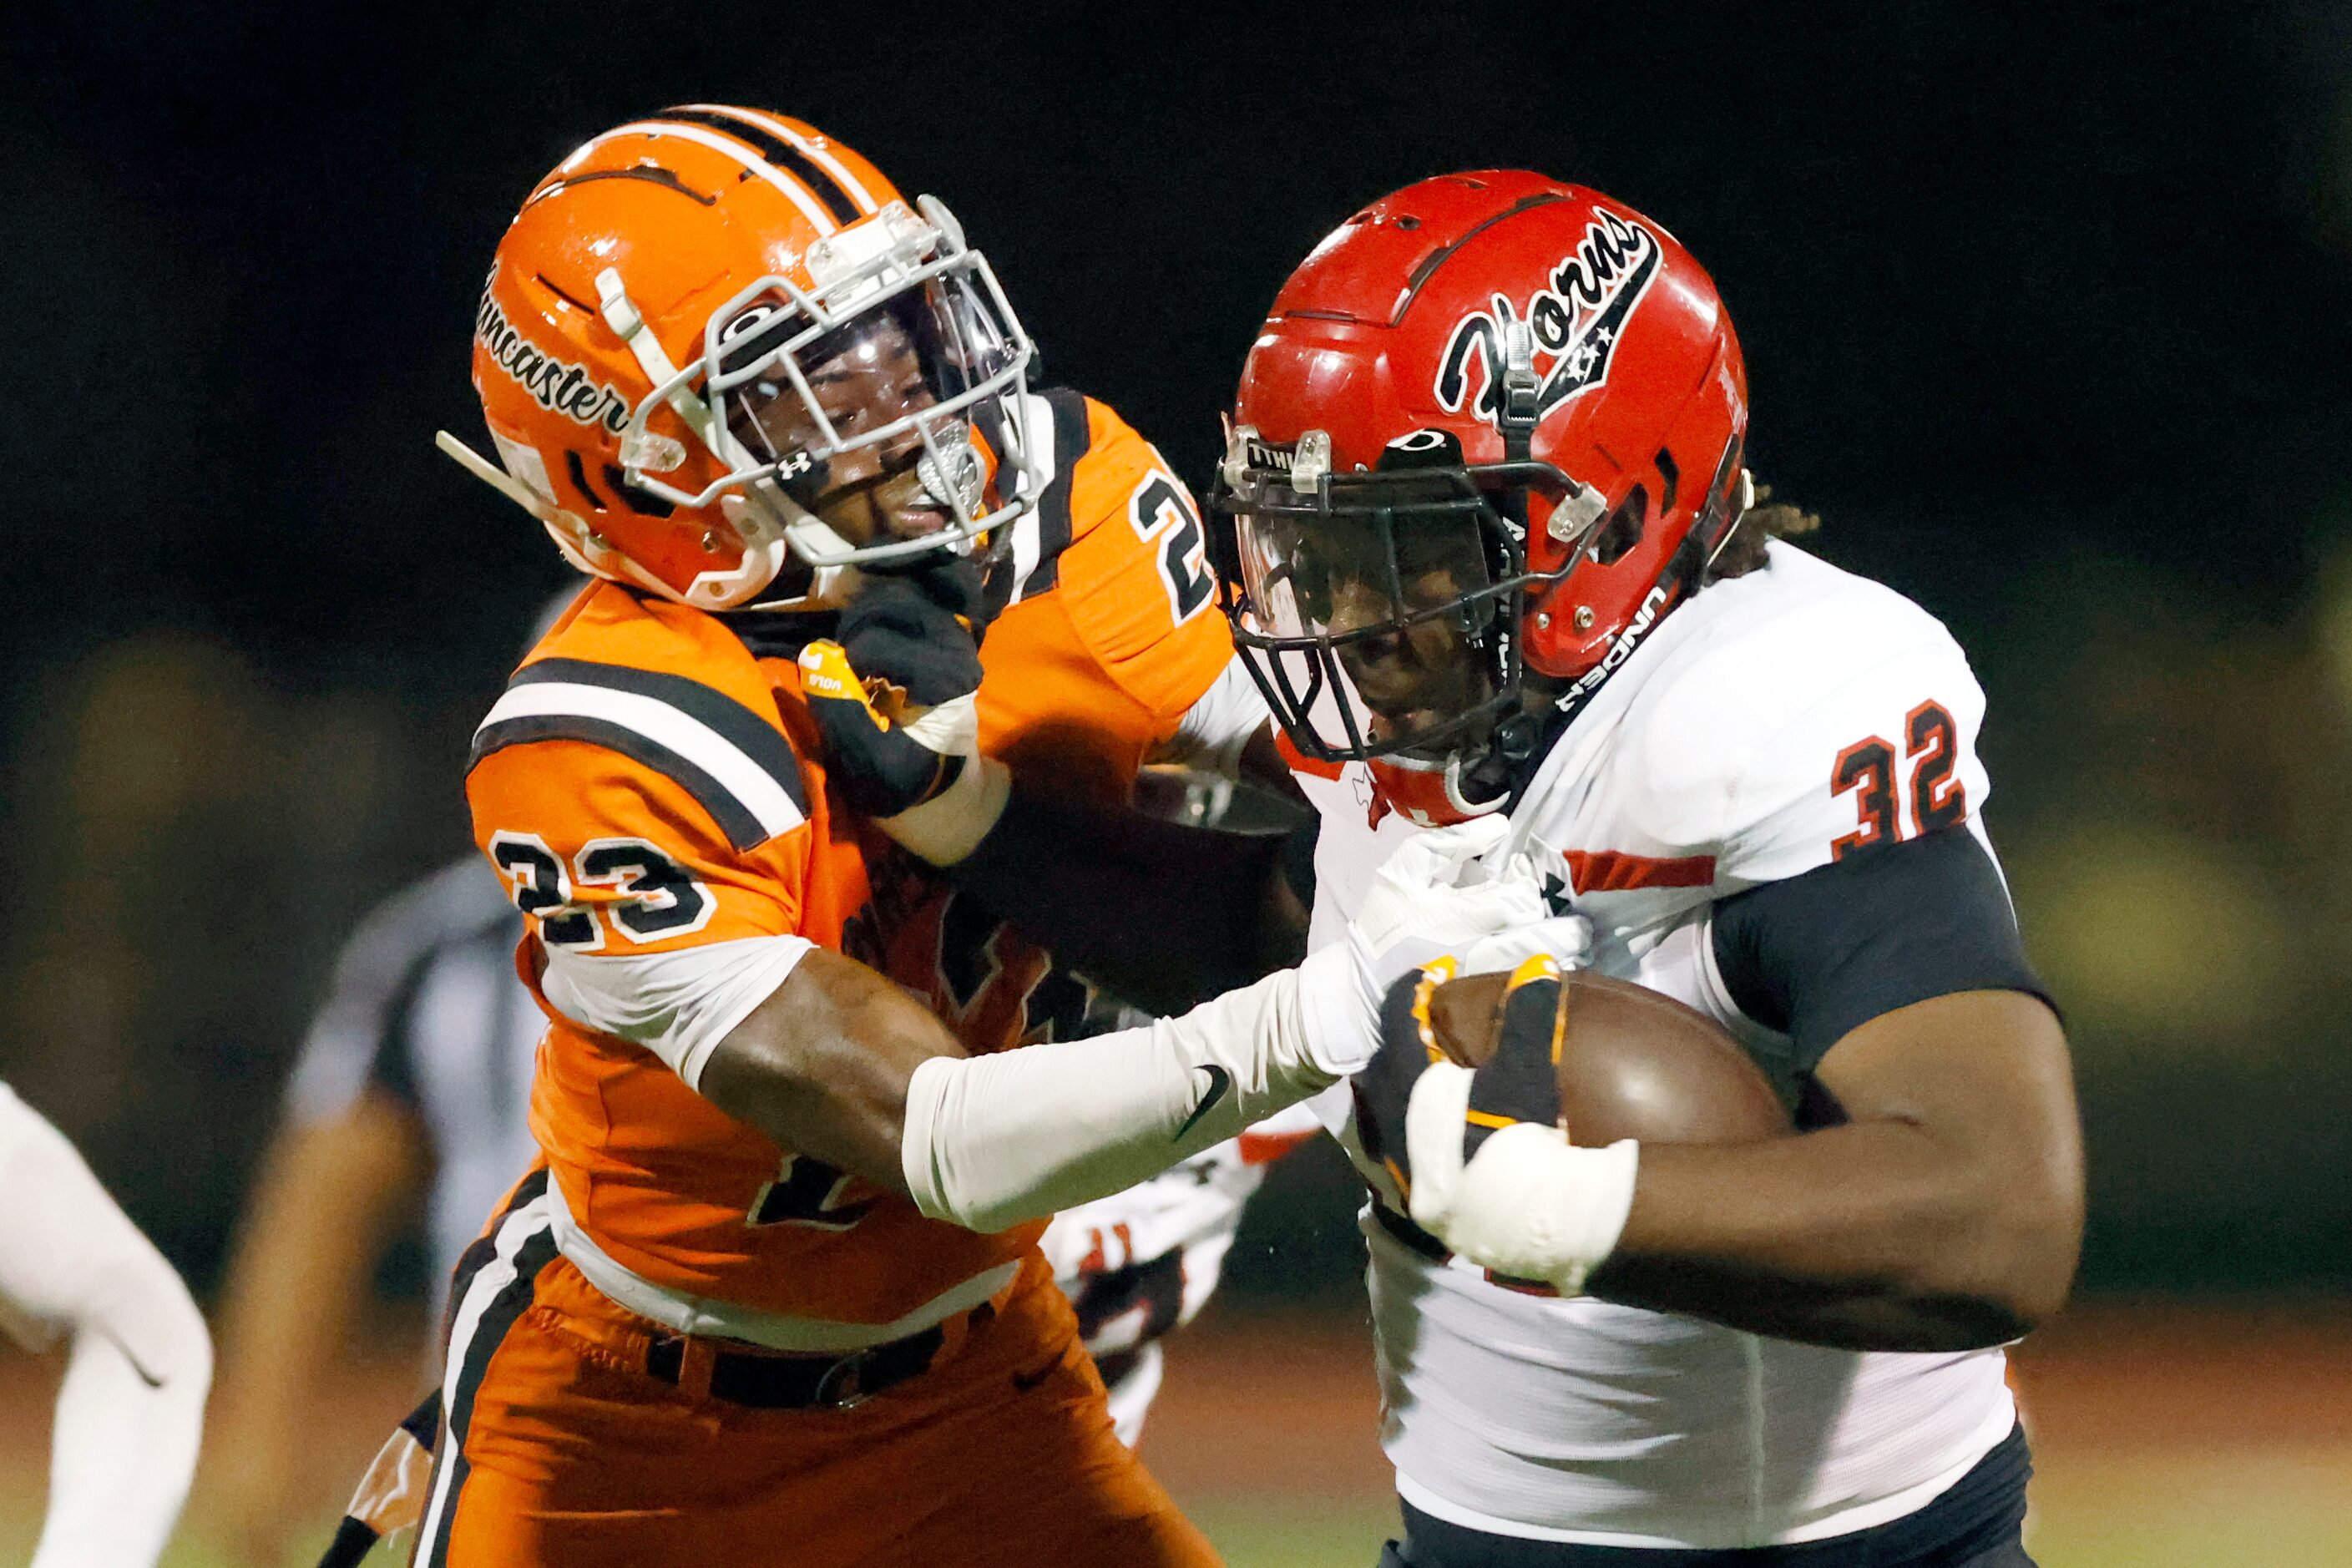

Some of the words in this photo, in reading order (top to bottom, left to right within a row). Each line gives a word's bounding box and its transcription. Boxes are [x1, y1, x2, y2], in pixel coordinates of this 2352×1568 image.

[1434, 205, 1663, 428] Horns
[1129, 468, 1216, 628] 2
[1830, 698, 1966, 862] 32
[488, 829, 718, 951] 23
